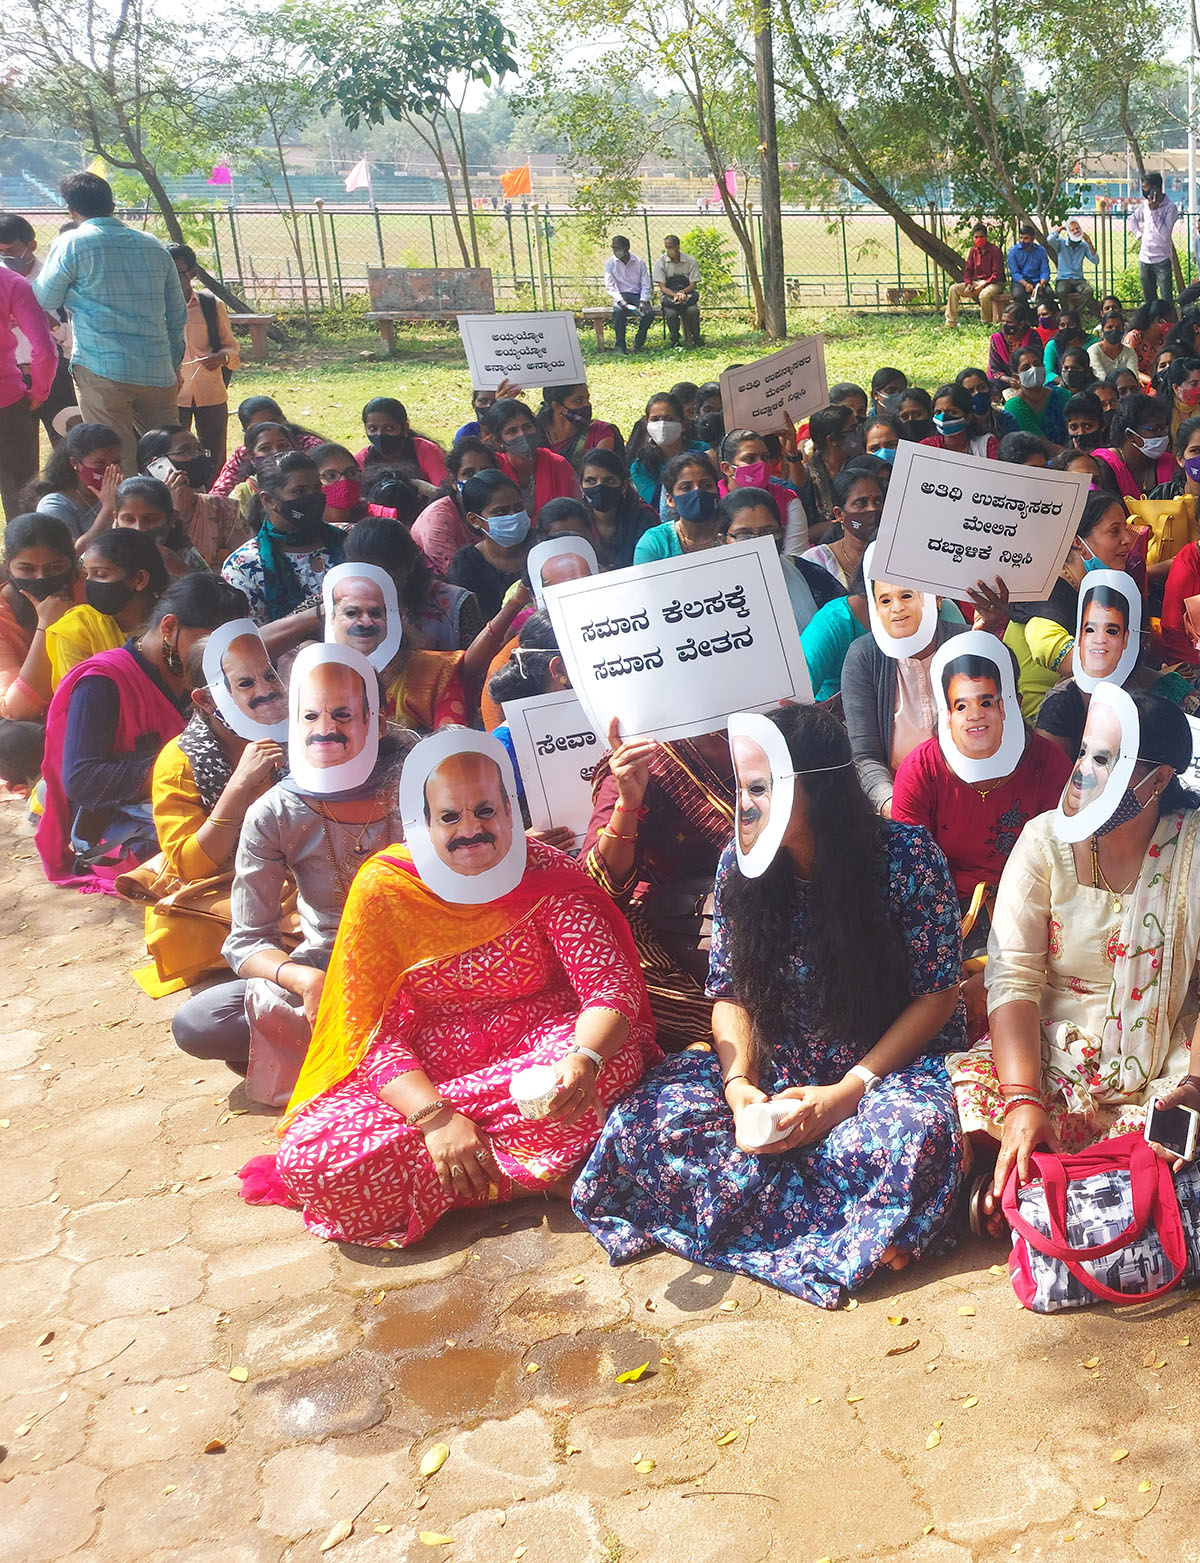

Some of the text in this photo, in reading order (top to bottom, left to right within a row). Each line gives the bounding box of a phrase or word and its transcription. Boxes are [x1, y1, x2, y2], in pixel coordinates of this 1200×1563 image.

[491, 331, 545, 345] ಅಯ್ಯಯ್ಯೋ
[495, 346, 548, 360] ಅಯ್ಯಯ್ಯೋ
[484, 360, 566, 376] ಅನ್ಯಾಯ ಅನ್ಯಾಯ
[920, 481, 1064, 519] ಅತಿಥಿ ಉಪನ್ಯಾಸಕರ
[962, 516, 1018, 538] ಮೇಲಿನ
[927, 537, 1033, 569] ದಬ್ಬಾಳಿಕೆ ನಿಲ್ಲಿಸಿ
[580, 585, 751, 643] ಸಮಾನ ಕೆಲಸಕ್ಕೆ
[592, 625, 754, 681] ಸಮಾನ ವೇತನ
[536, 731, 597, 755] ಸೇವಾ
